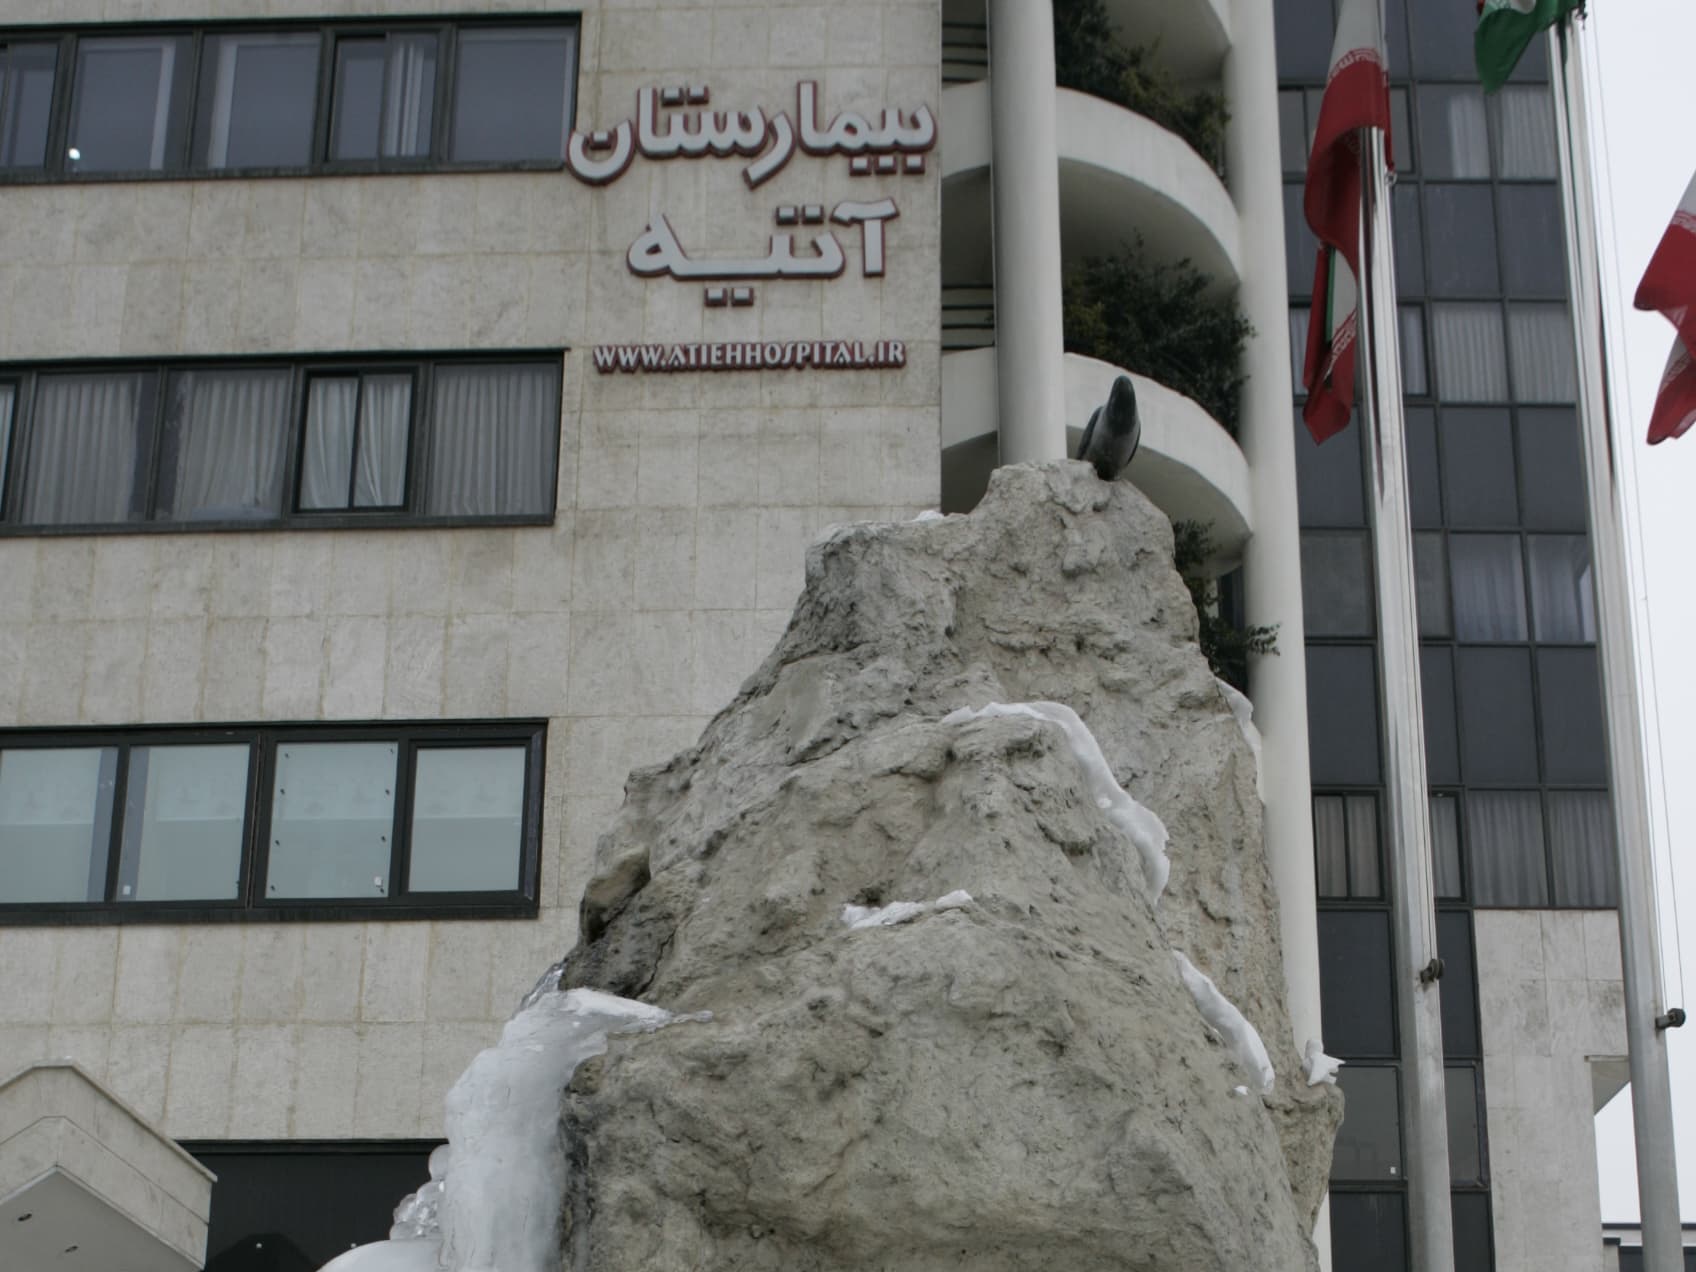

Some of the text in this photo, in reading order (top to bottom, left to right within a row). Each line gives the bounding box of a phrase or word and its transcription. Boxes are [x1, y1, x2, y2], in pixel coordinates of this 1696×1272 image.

[567, 80, 936, 190] بیمارستان
[627, 197, 900, 307] آتیه
[594, 341, 906, 374] WWW.ATIEHHOSPITAL.IR
